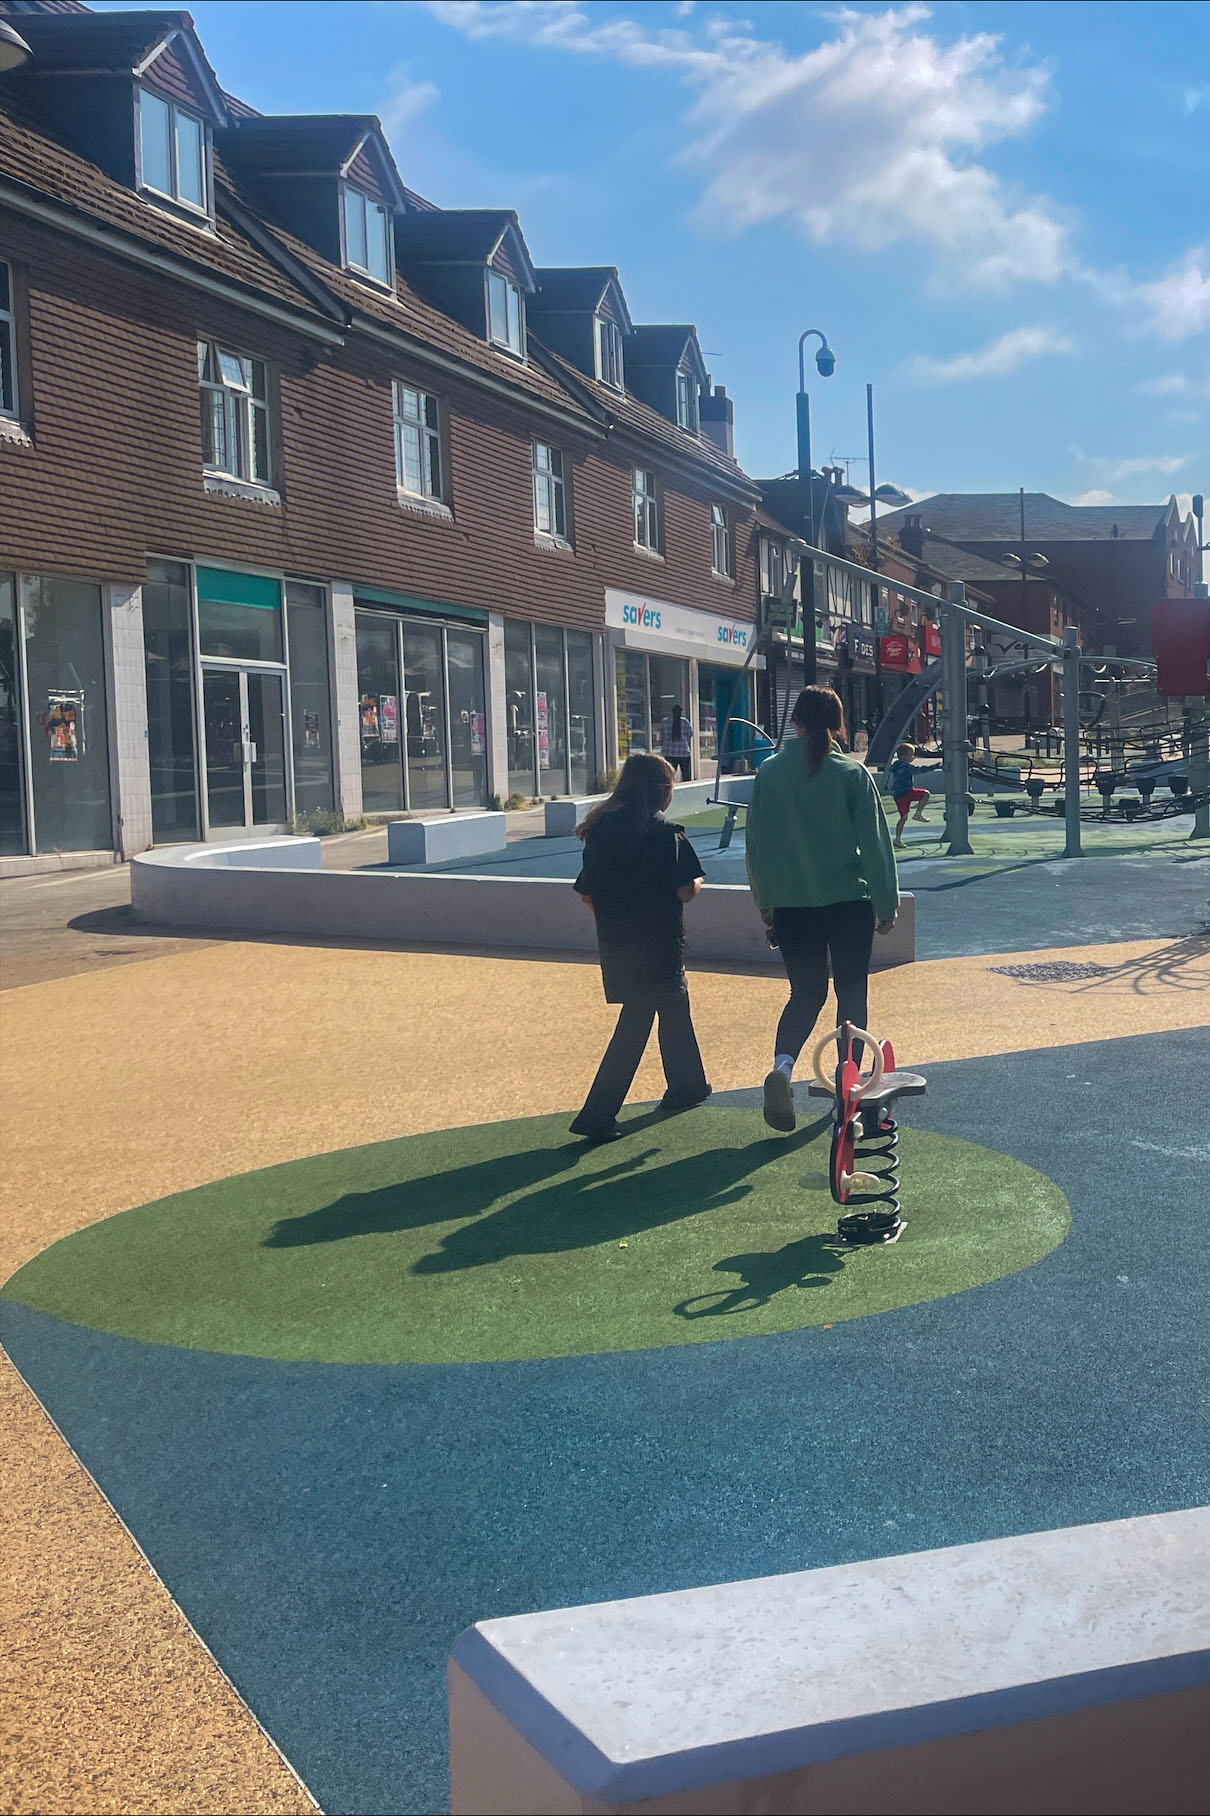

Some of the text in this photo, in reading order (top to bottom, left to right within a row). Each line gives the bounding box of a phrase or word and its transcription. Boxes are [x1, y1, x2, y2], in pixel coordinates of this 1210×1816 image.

[623, 602, 661, 629] savers
[717, 624, 747, 646] savers
[854, 639, 874, 656] FDES
